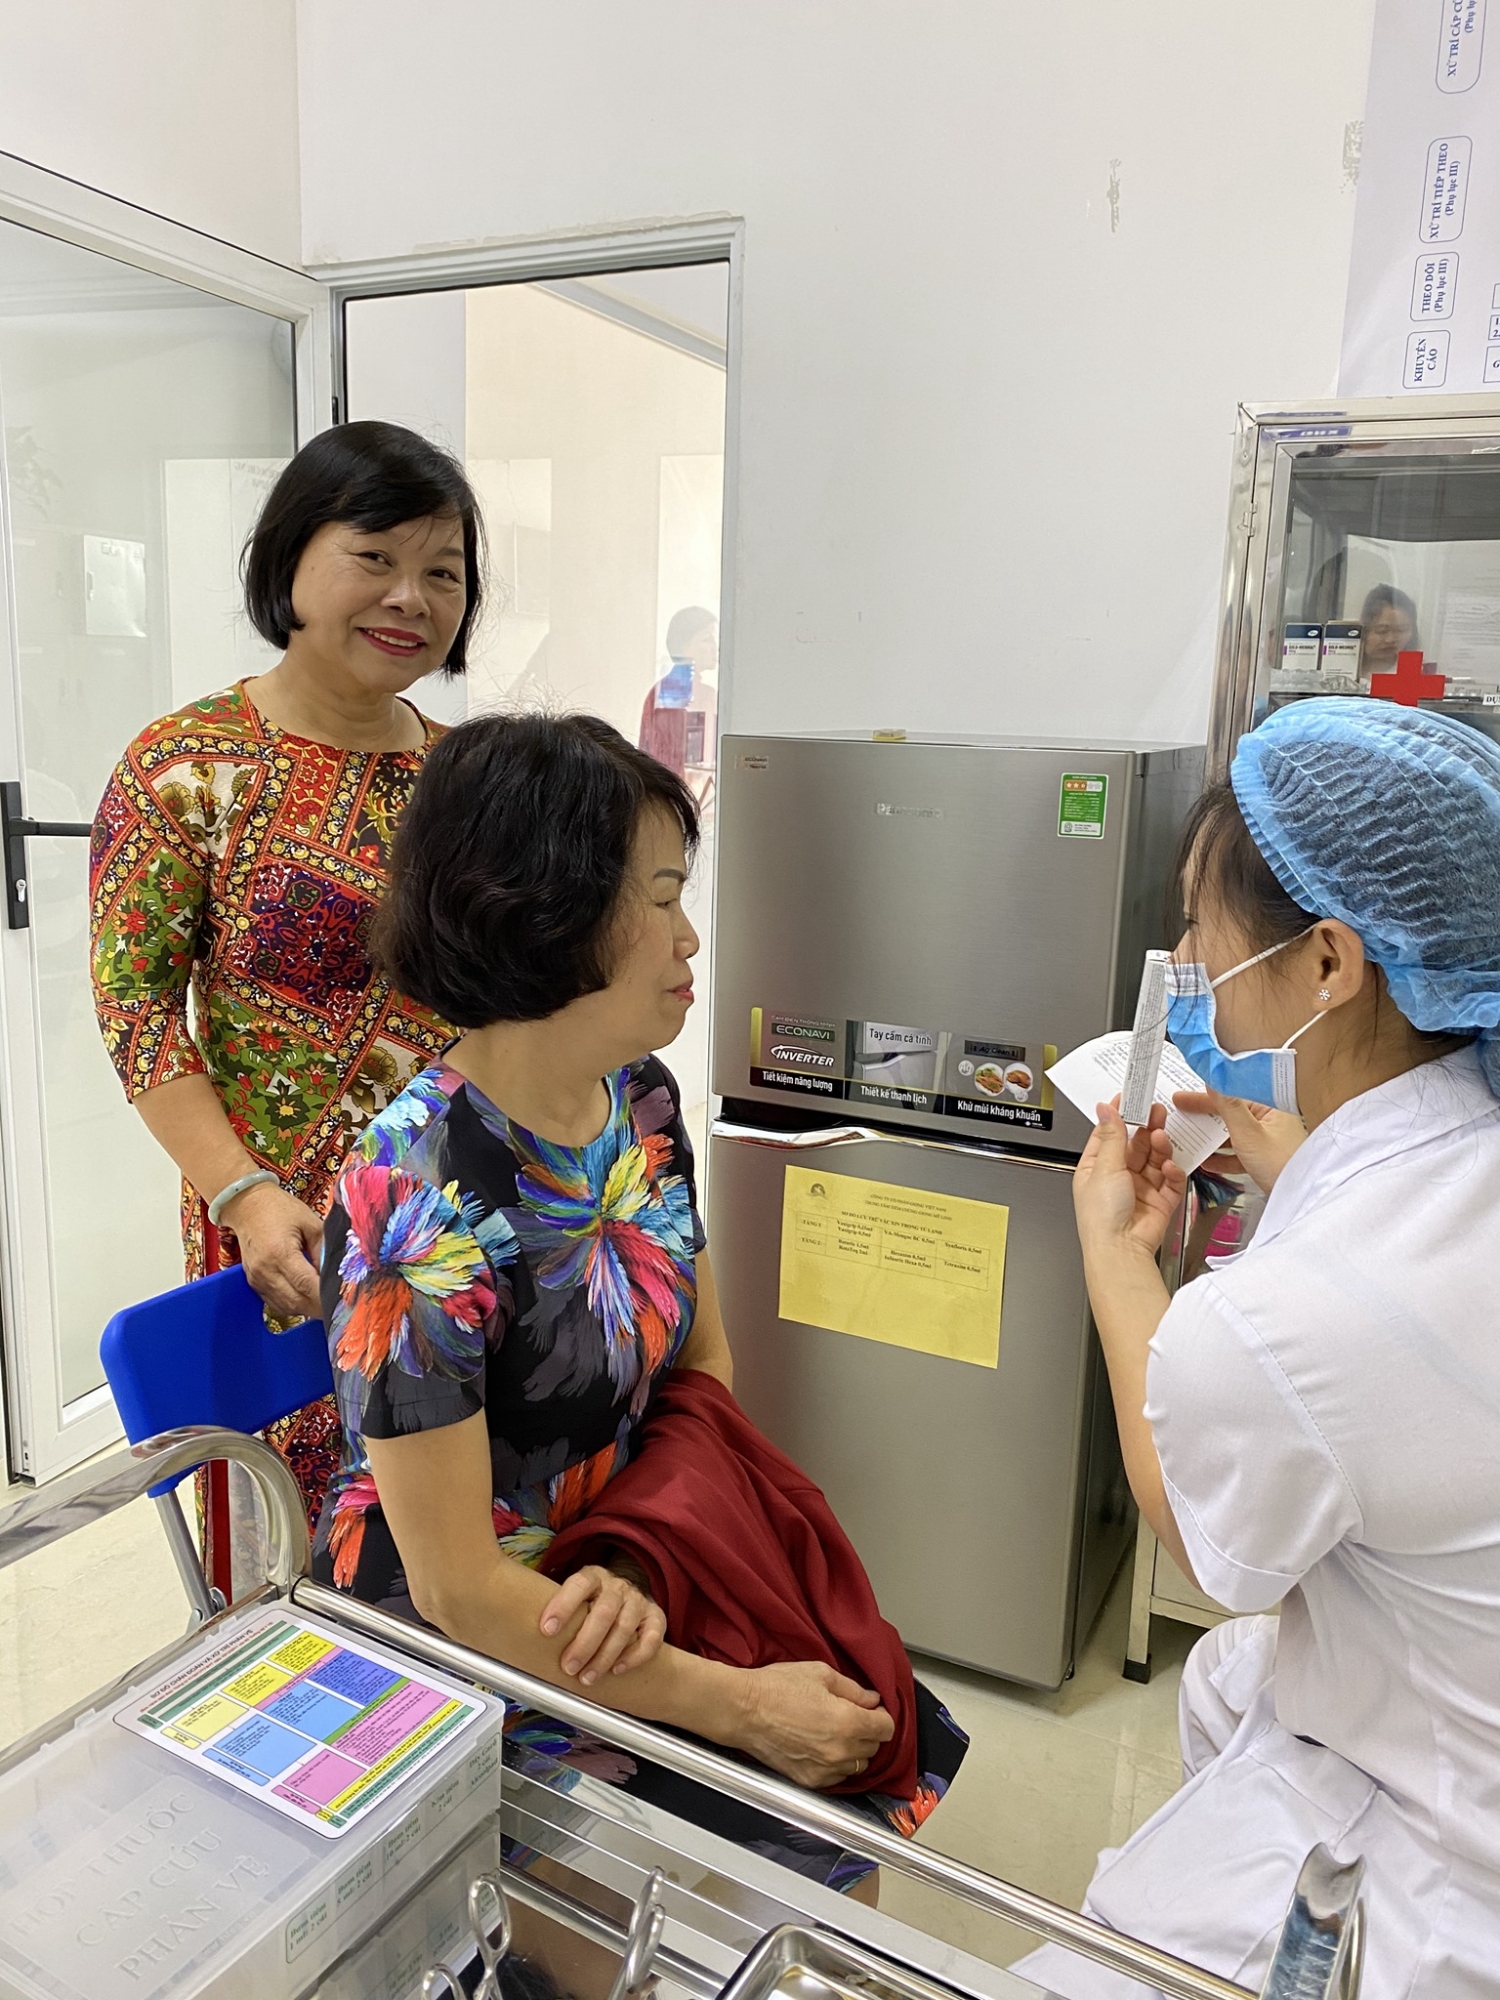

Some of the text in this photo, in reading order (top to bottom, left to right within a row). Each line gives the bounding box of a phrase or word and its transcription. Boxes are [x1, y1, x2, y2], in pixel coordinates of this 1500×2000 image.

[1452, 0, 1463, 13] CỨ
[1464, 0, 1476, 33] (Phụ lụ
[1448, 39, 1460, 58] TRÍ
[1446, 60, 1458, 78] XỬ
[1429, 143, 1448, 239] XỬ TRÍ TIẾP THEO
[1444, 160, 1460, 216] (Phụ lục III)
[1434, 258, 1449, 313] (Phụ lục III)
[1421, 284, 1433, 313] THEO
[1413, 338, 1427, 382] KHUYẾN
[1426, 348, 1438, 371] CÁO
[776, 1024, 830, 1040] ECONAVI
[870, 1028, 883, 1041] Tay
[904, 1033, 914, 1043] cá
[916, 1035, 932, 1045] tính
[777, 1049, 835, 1066] INVERTER
[762, 1070, 833, 1092] Tiết kiệm năng lượng
[860, 1086, 928, 1105] Thiết kế thanh lịch
[958, 1100, 1041, 1122] Khử mùi kháng khuẩn
[78, 1794, 195, 1876] THUỐC
[150, 1828, 222, 1888] CỨU
[114, 1894, 224, 1980] PHẢN
[212, 1854, 270, 1892] VỆ
